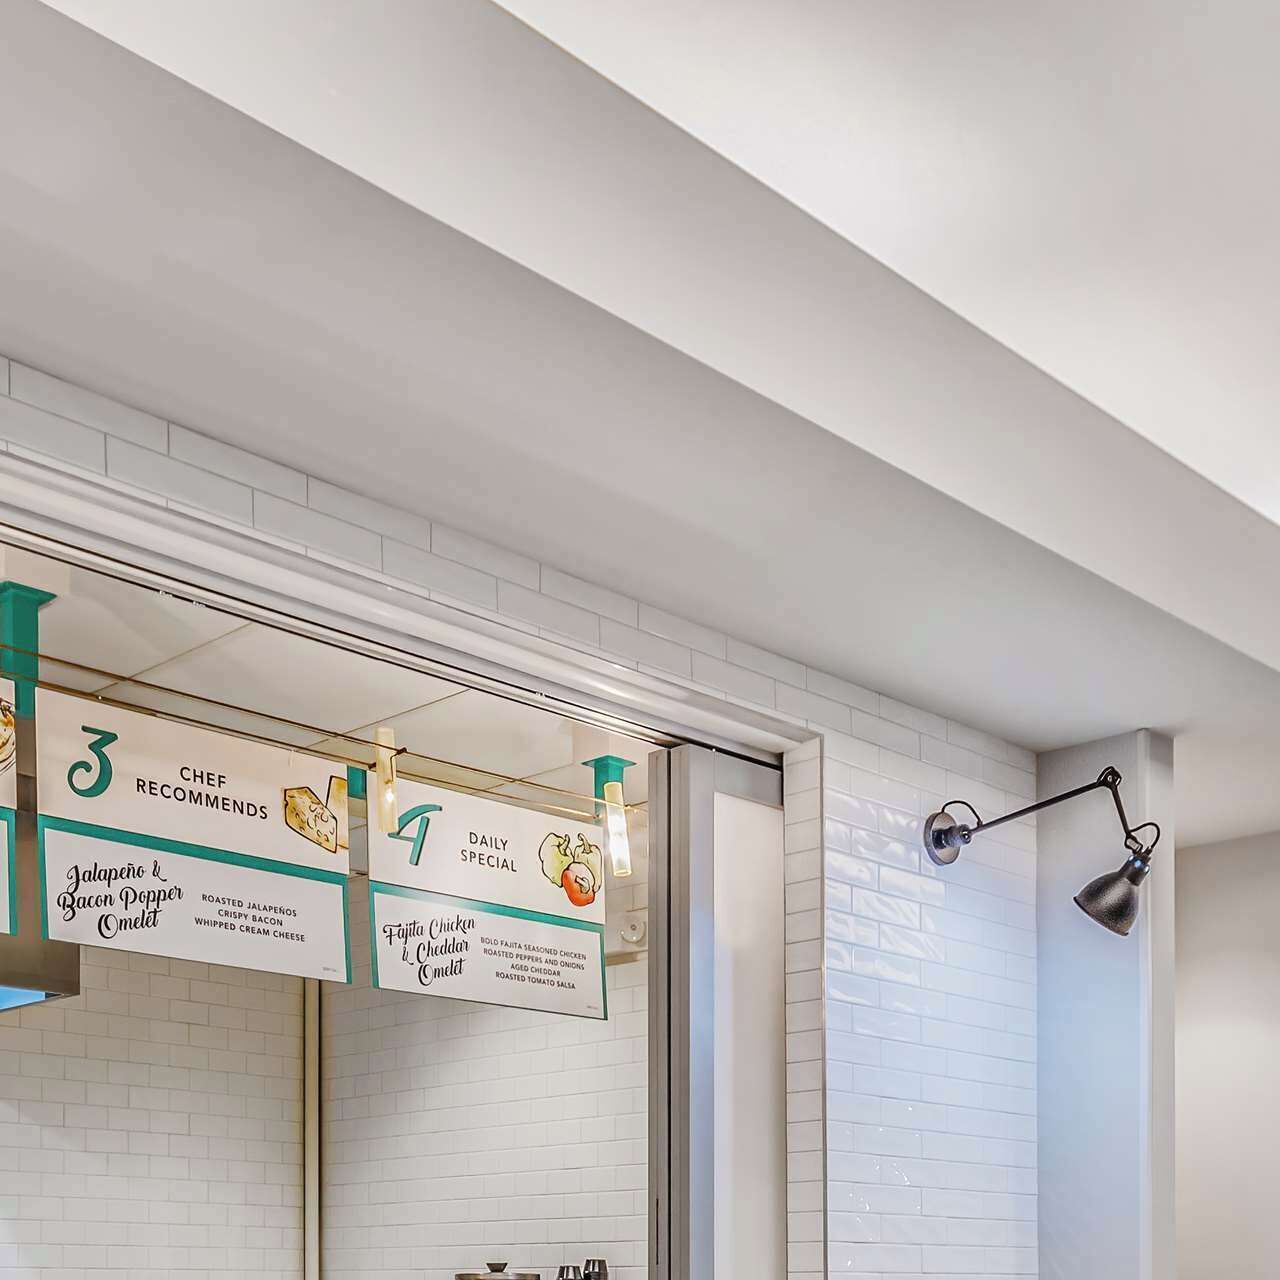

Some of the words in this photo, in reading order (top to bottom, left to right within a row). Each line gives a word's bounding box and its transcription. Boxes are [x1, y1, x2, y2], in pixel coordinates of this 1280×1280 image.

[67, 725, 118, 797] 3
[179, 766, 227, 789] CHEF
[135, 778, 268, 820] RECOMMENDS
[469, 832, 508, 852] DAILY
[460, 849, 517, 872] SPECIAL
[66, 863, 146, 894] Jalapeño
[152, 860, 167, 882] &
[56, 891, 116, 922] Bacon
[119, 884, 184, 911] Popper
[201, 893, 244, 909] ROASTED
[97, 908, 163, 940] Omelet
[194, 917, 237, 932] WHIPPED
[239, 924, 271, 937] CREAM
[272, 930, 306, 943] CHEESE
[217, 909, 250, 924] CRISPY
[252, 914, 283, 927] BACON
[383, 920, 425, 947] Fajita
[429, 914, 475, 940] Chicken
[416, 936, 470, 964] Cheddar
[480, 936, 499, 946] BOLD
[500, 939, 523, 950] FAJITA
[524, 943, 558, 956] SEASONED
[559, 949, 587, 961] CHICKEN
[483, 948, 514, 959] ROASTED
[515, 952, 543, 963] PEPPERS
[544, 957, 559, 967] AND
[560, 960, 585, 971] ONIONS
[417, 957, 466, 987] Omelet
[495, 971, 526, 982] ROASTED
[527, 976, 555, 987] TOMATO
[556, 980, 576, 989] SALSA
[510, 963, 529, 973] AGED
[530, 965, 561, 977] CHEDDAR
